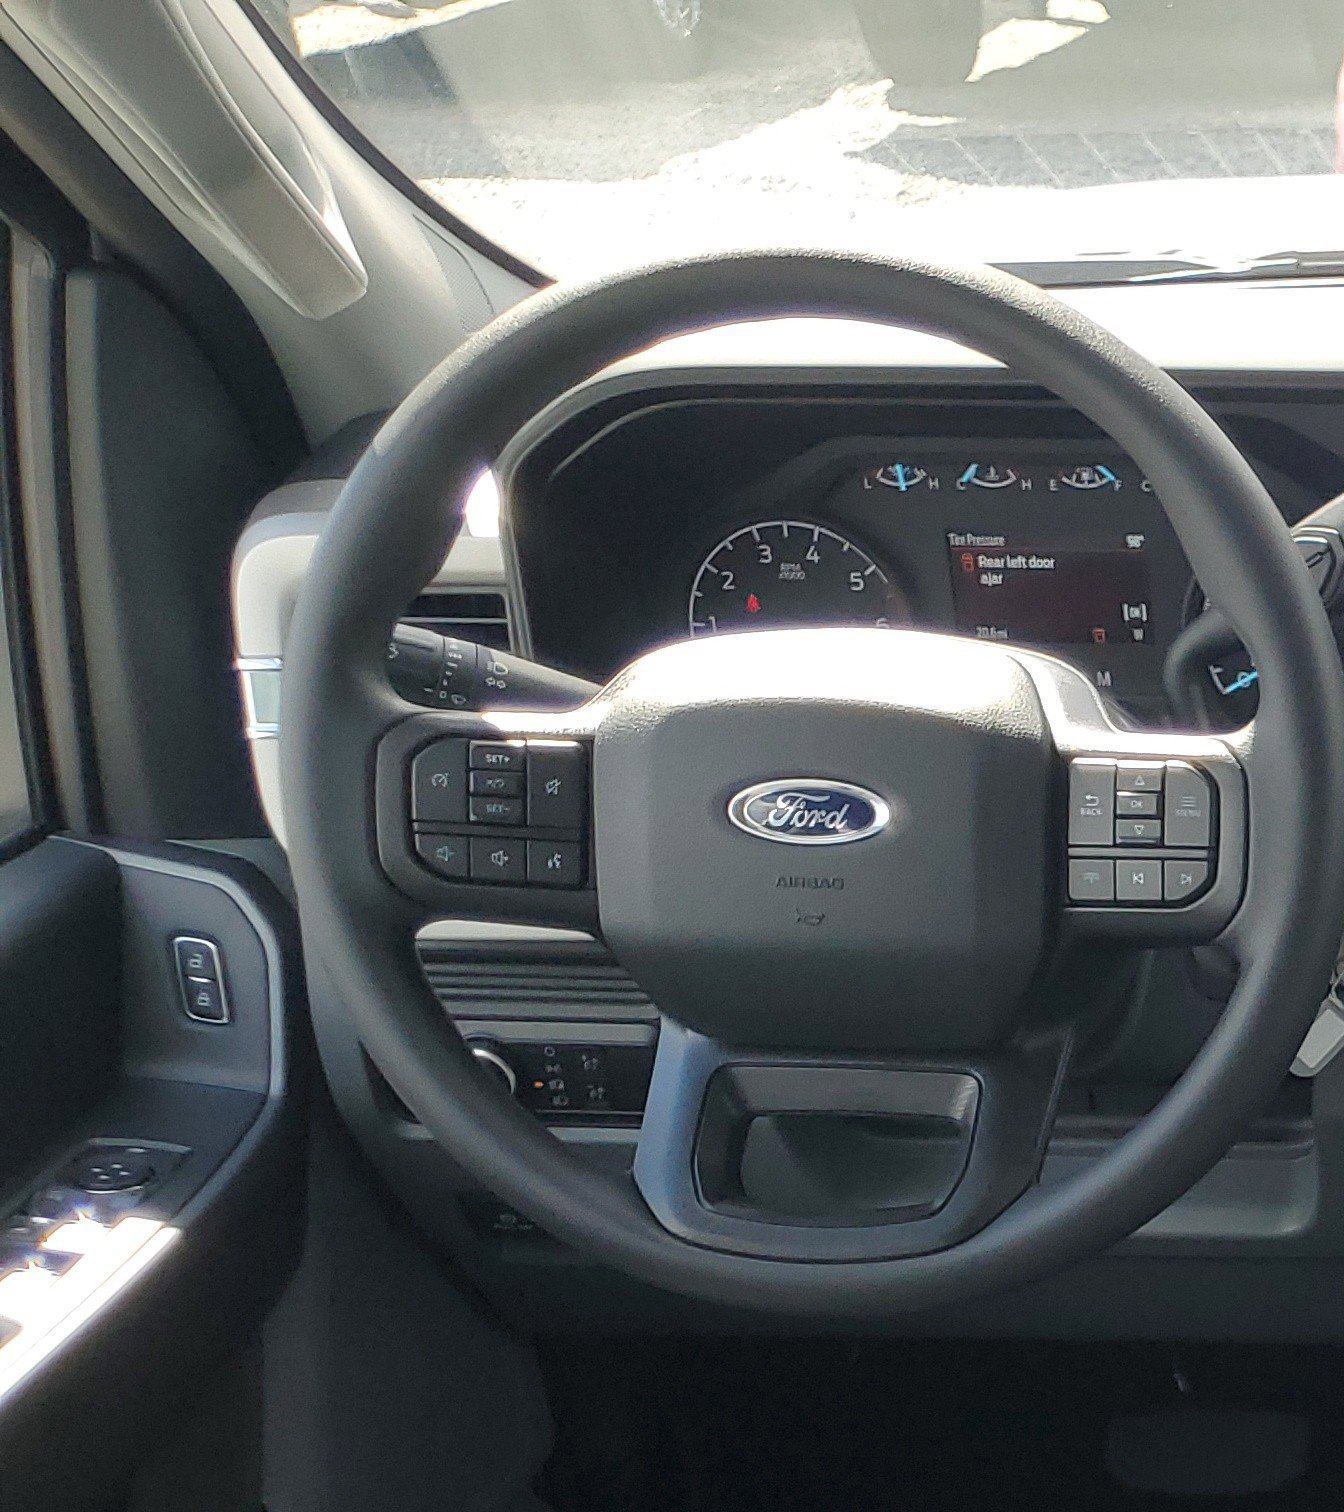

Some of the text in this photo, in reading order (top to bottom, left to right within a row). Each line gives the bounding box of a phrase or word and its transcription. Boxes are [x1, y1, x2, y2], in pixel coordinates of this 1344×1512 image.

[756, 544, 773, 564] 3
[805, 545, 821, 564] 4
[977, 555, 1056, 569] Rear left door
[720, 571, 735, 590] 2
[849, 571, 865, 591] 5
[979, 572, 1003, 587] ajar
[762, 791, 850, 830] Ford
[774, 876, 846, 890] AIRBAG
